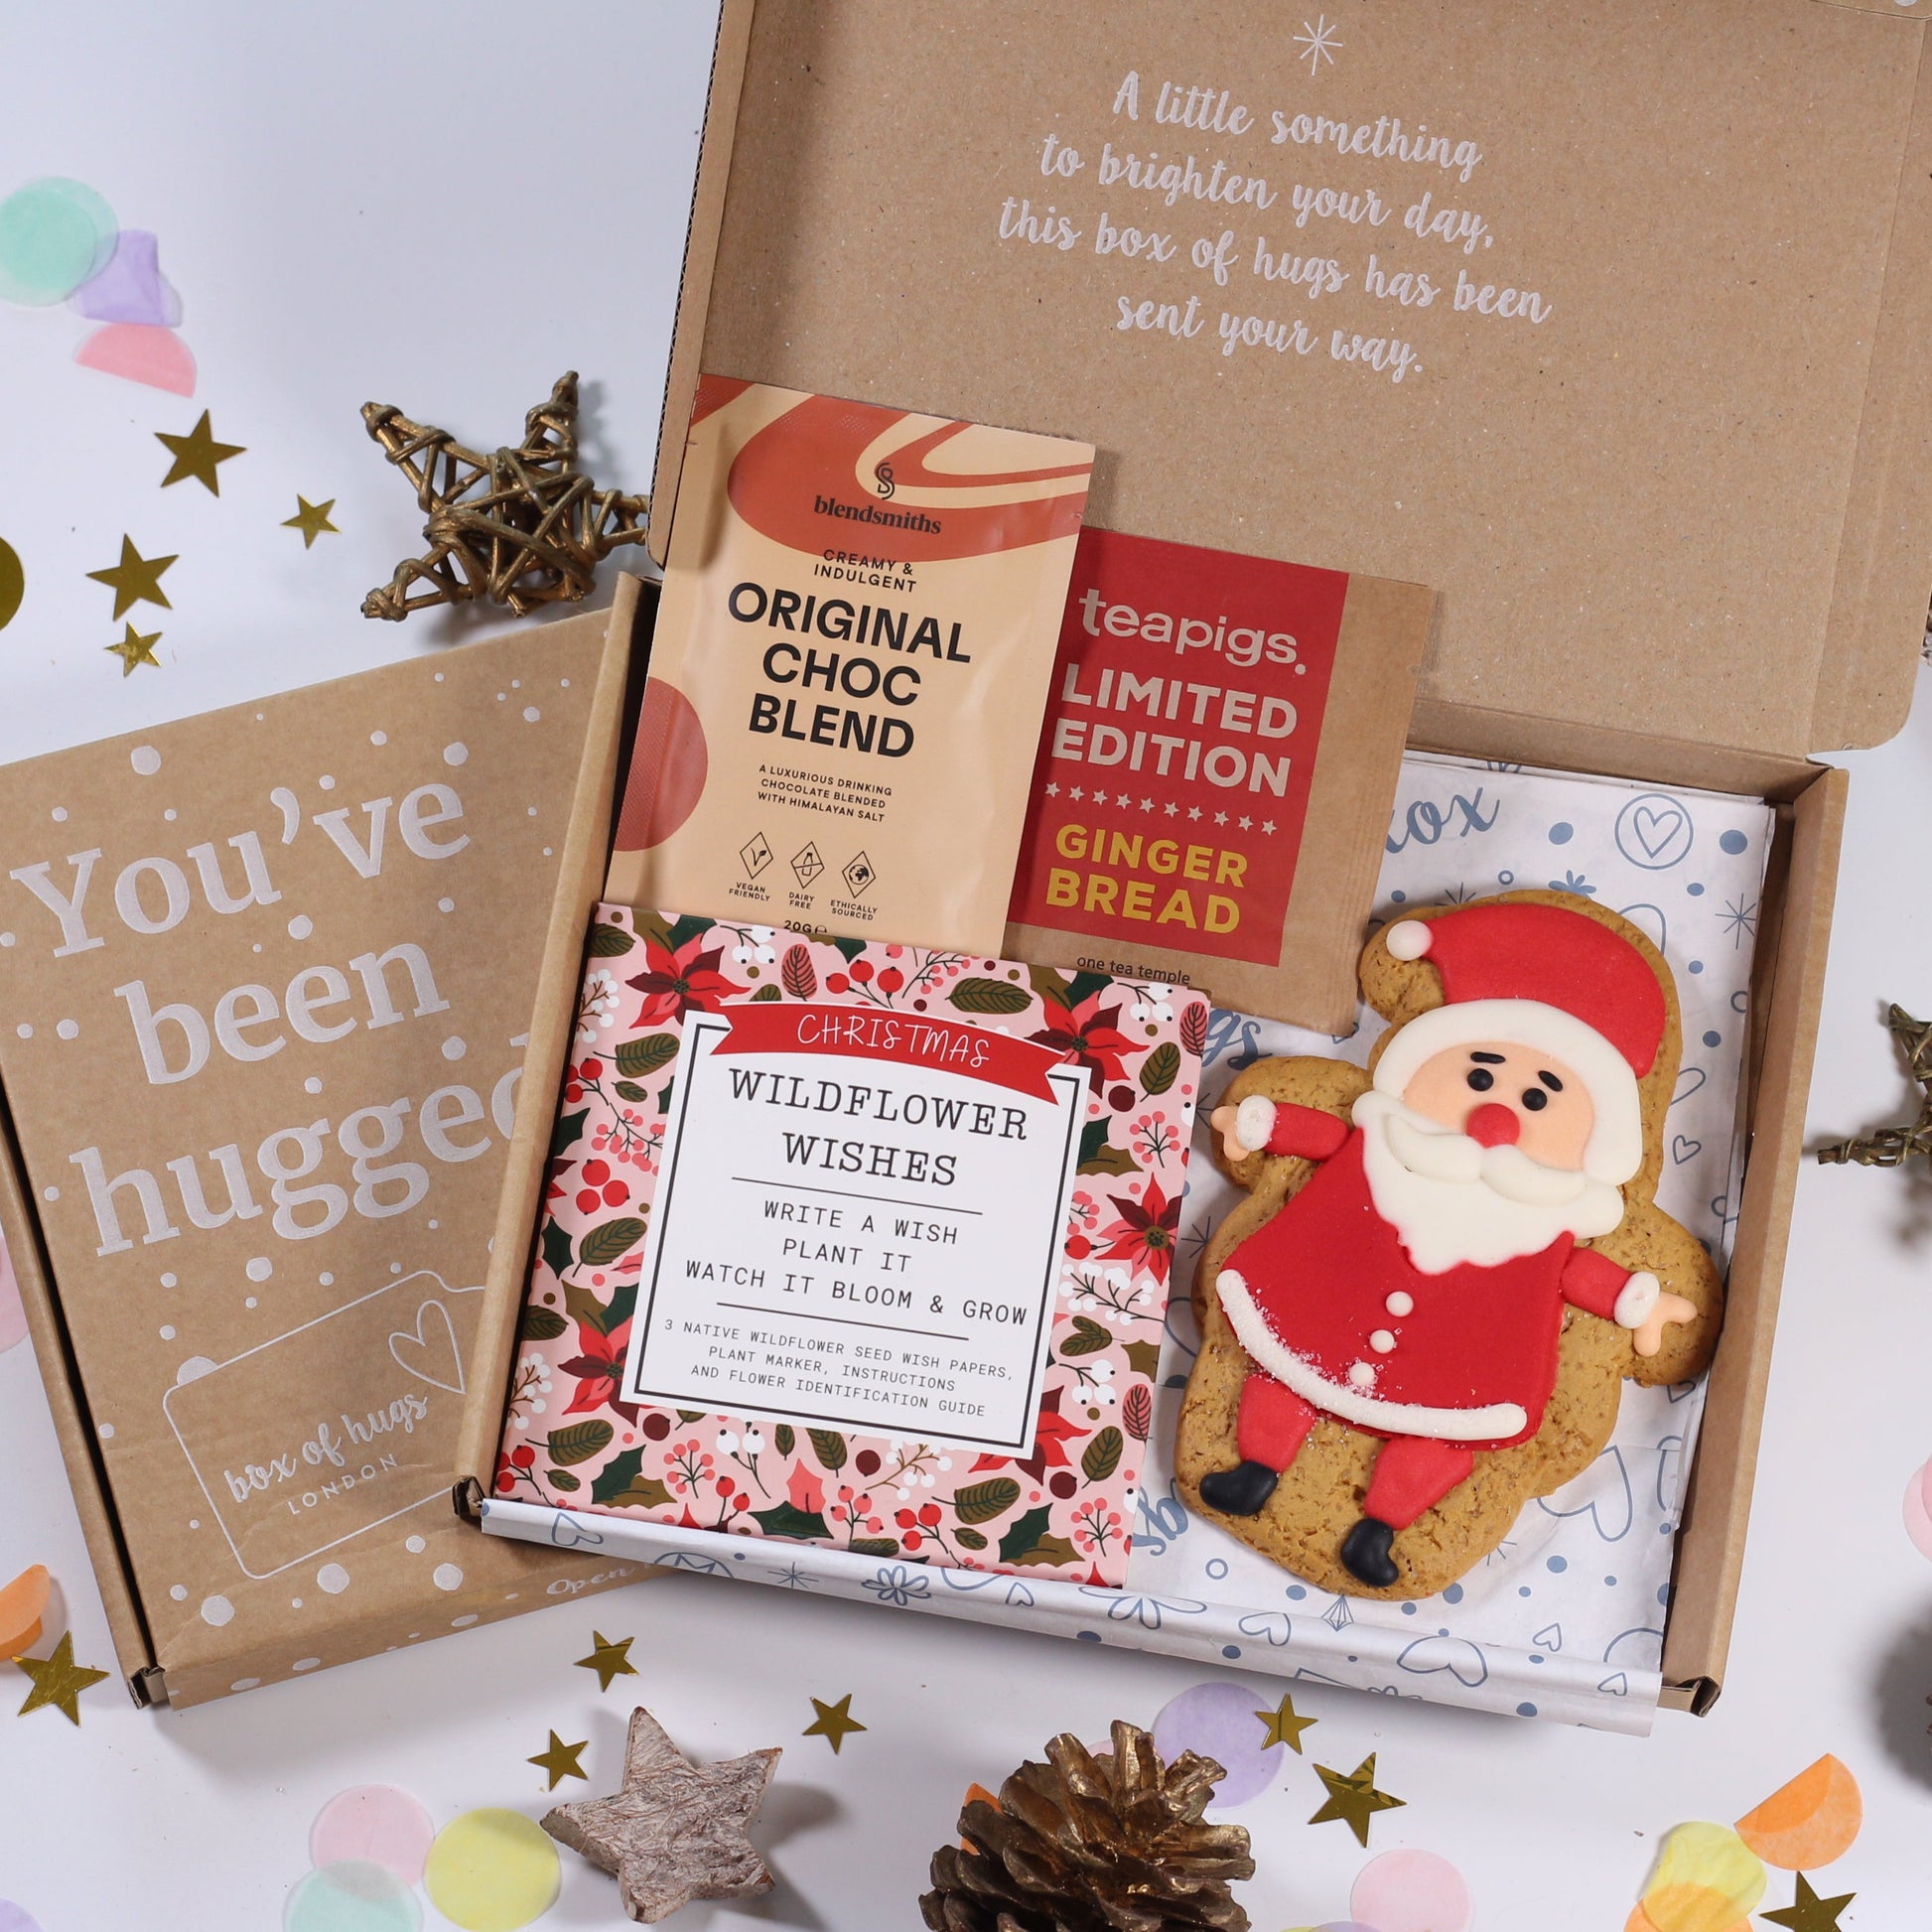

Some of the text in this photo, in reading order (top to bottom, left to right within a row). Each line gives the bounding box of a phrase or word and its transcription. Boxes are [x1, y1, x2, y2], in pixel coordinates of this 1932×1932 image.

[1112, 70, 1482, 182] A little something
[1039, 133, 1494, 254] to brighten your day,
[998, 197, 1553, 324] this box of hugs has been
[1116, 295, 1423, 383] sent your way.
[814, 495, 941, 534] blendsmiths
[814, 564, 916, 593] INDULGENT
[823, 549, 913, 575] CREAMY &
[728, 582, 971, 663] ORIGINAL
[1078, 589, 1307, 676] teapigs.
[761, 642, 921, 706] CHOC
[1060, 663, 1298, 739] LIMITED
[748, 692, 914, 758] BLEND
[769, 765, 834, 785] LUXURIOUS
[837, 778, 893, 796] DRINKING
[1051, 717, 1292, 797] EDITION
[758, 791, 885, 822] WITH HIMALAYAN SALT
[760, 778, 886, 808] CHOCOLATE BLENDED
[9, 782, 471, 958] You’ve
[1055, 824, 1249, 888] GINGER
[729, 889, 770, 902] FRIENDLY
[736, 882, 765, 894] VEGAN
[788, 892, 815, 902] DAIRY
[789, 899, 812, 909] FREE
[830, 899, 879, 914] ETHICALLY
[831, 907, 874, 921] SOURCED
[1045, 868, 1240, 935] BREAD
[1076, 956, 1190, 985] one tea temple
[113, 943, 451, 1085] been
[796, 1013, 990, 1068] CHRISTMAS
[729, 1068, 1029, 1140] WILDFLOWER
[782, 1132, 958, 1186] WISHES
[763, 1199, 958, 1245] WRITE A WISH
[782, 1237, 912, 1273] PLANT IT
[685, 1259, 1029, 1325] WATCH IT BLOOM & GROW
[664, 1318, 1014, 1382] 3 NATIVE WILDFLOWER SEED WISH PAPERS,
[709, 1346, 956, 1392] PLANT MARKER, INSTRUCTIONS
[690, 1364, 986, 1417] AND FLOWER IDENTIFICATION GUIDE
[223, 1394, 428, 1504] box of hugs
[288, 1452, 398, 1515] LONDON
[547, 1567, 635, 1594] Open
